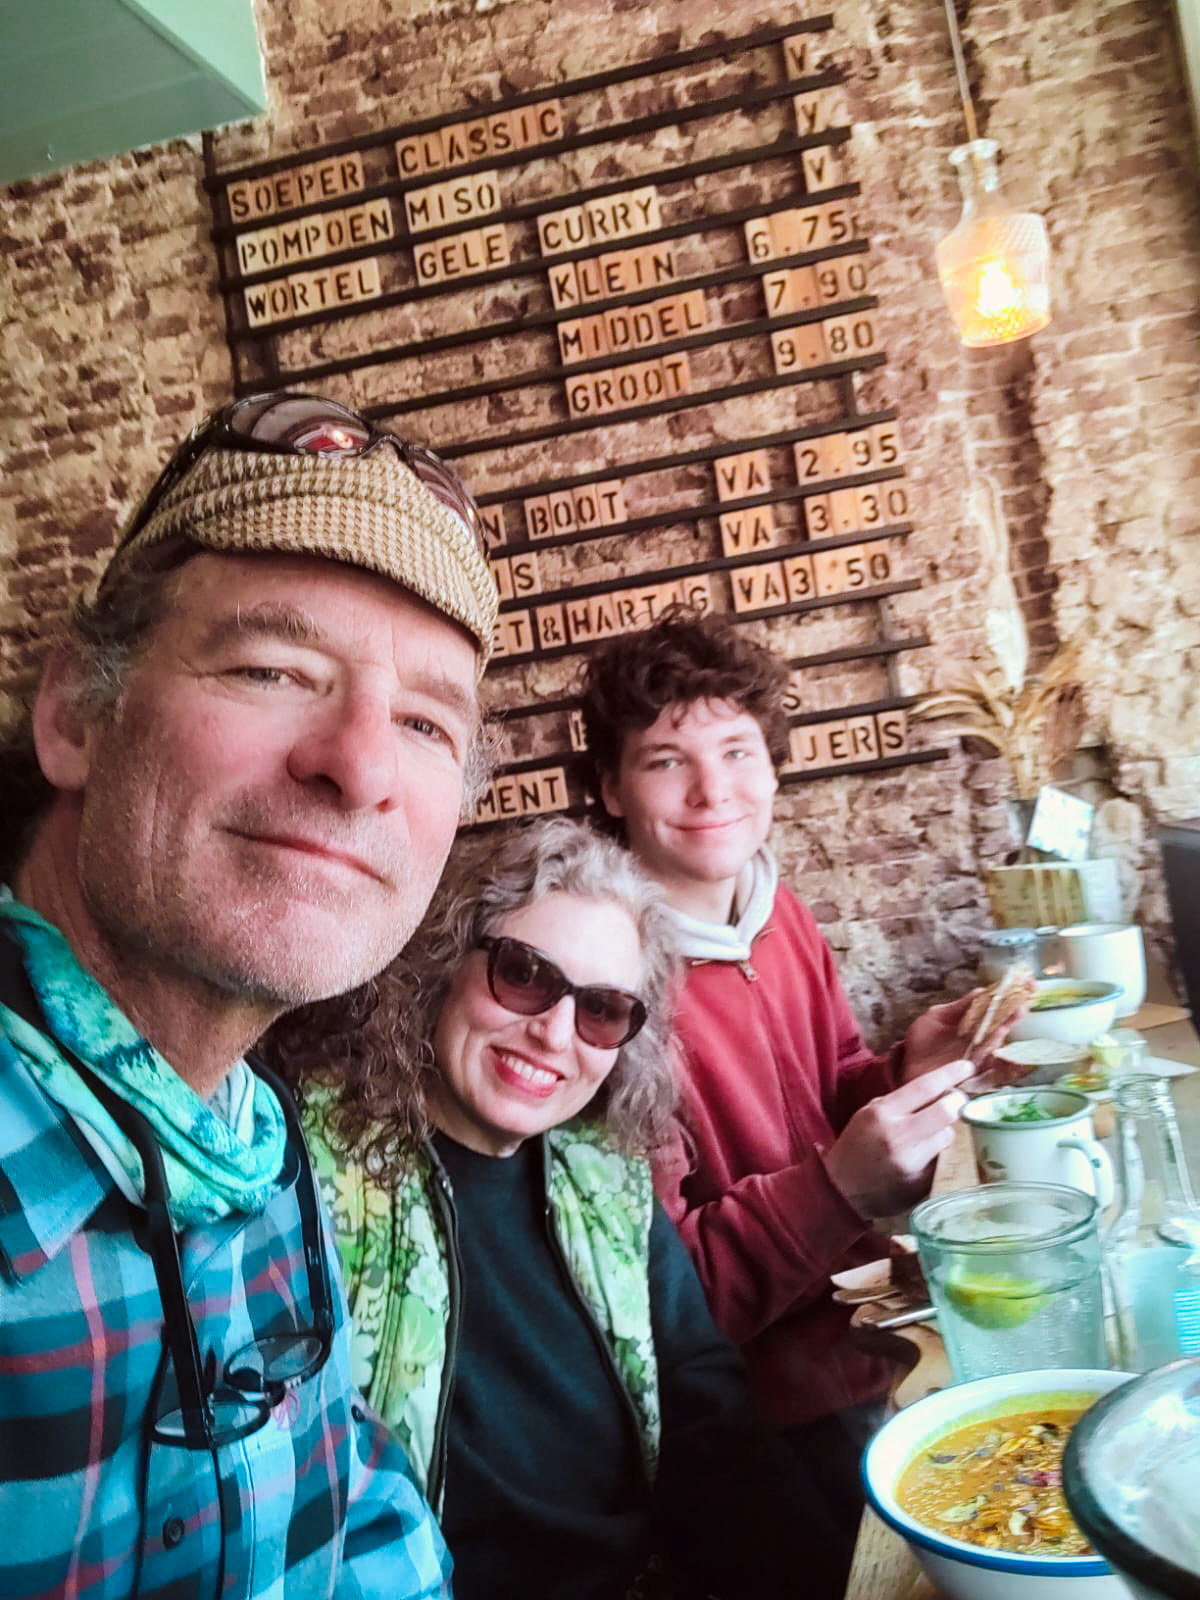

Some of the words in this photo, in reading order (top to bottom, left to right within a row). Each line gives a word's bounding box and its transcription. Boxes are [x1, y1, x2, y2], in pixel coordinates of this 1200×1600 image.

[231, 162, 361, 218] SOEPER
[400, 108, 559, 174] CLASSIC
[789, 43, 807, 73] V
[241, 208, 391, 269] POMPOEN
[407, 183, 497, 227] MISO
[247, 269, 375, 319] WORTEL
[418, 234, 506, 280] GELE
[543, 196, 652, 249] CURRY
[808, 156, 825, 182] V
[555, 252, 674, 303] KLEIN
[751, 210, 848, 258] 6.75
[562, 303, 703, 358] MIDDEL
[770, 264, 867, 310] 7.90
[571, 362, 683, 413] GROOT
[778, 320, 874, 367] 9.80
[530, 492, 618, 536] BOOT
[721, 461, 765, 493] VA
[801, 434, 898, 478] 2.95
[726, 517, 771, 548] VA
[811, 489, 908, 532] 3.30
